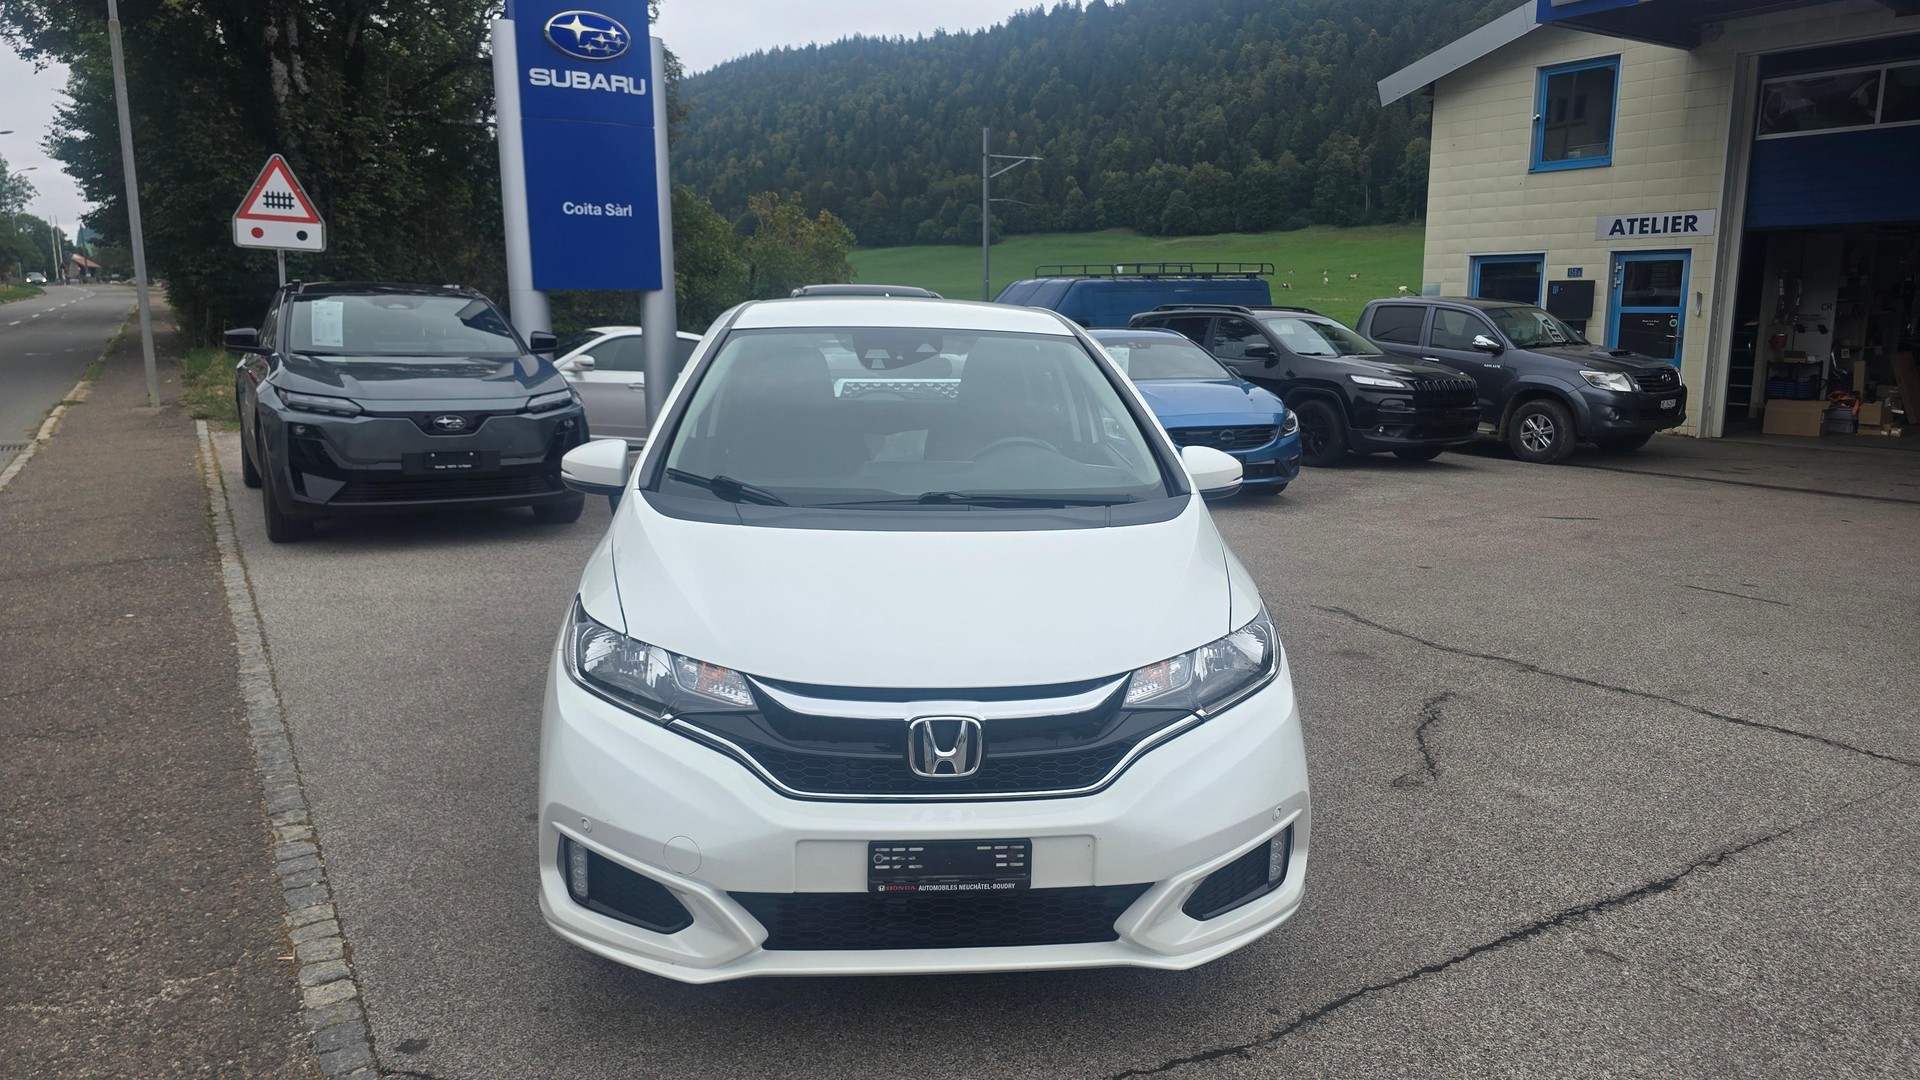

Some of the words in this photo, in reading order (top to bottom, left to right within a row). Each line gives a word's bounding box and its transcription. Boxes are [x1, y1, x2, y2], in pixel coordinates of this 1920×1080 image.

[529, 68, 646, 95] SUBARU
[562, 201, 602, 215] Coita
[605, 203, 632, 217] Sàrl
[1609, 214, 1698, 236] ATELIER
[958, 882, 1016, 891] NEUCHÂTEL-BOUDRY
